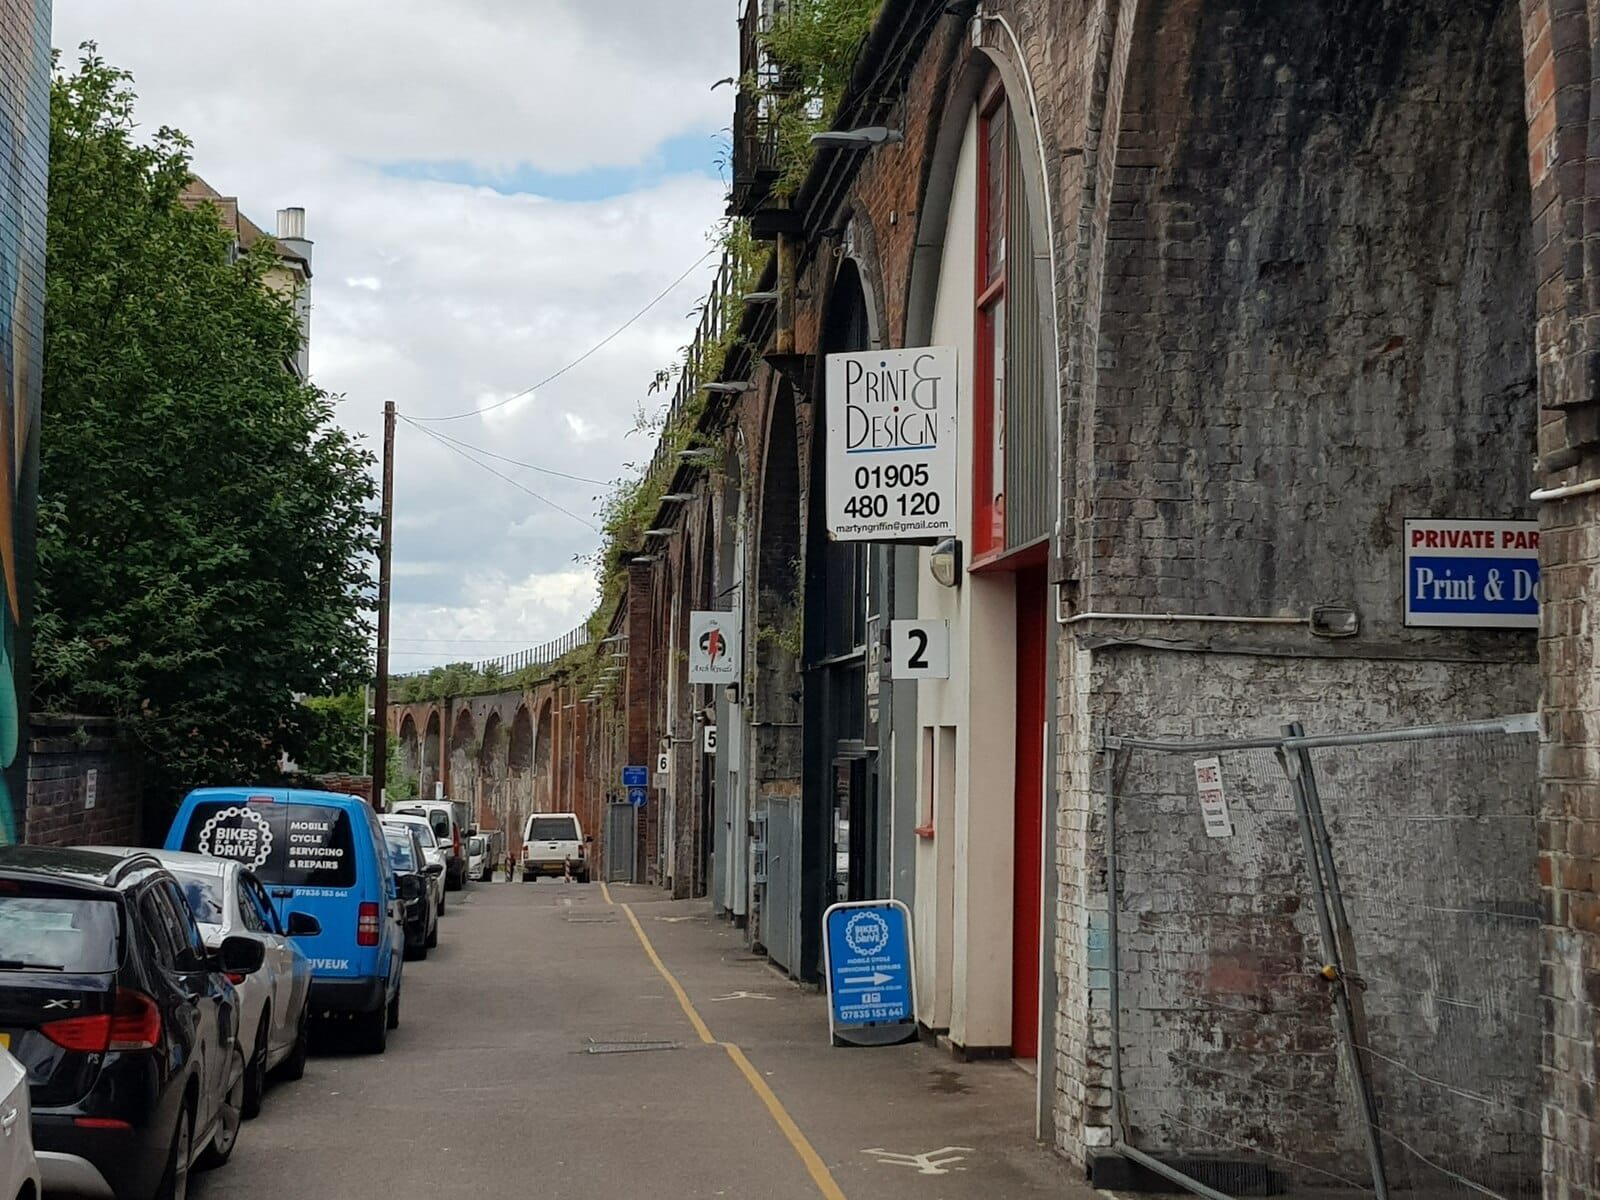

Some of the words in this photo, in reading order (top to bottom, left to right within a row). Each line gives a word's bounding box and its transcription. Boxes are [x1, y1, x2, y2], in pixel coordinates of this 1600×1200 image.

[855, 463, 929, 489] 01905
[844, 494, 888, 518] 480
[896, 492, 940, 516] 120
[836, 520, 949, 533] martyngriffin@gmail.com
[1411, 530, 1495, 549] PRIVATE
[1415, 567, 1476, 600] Print
[1483, 568, 1504, 601] &
[908, 629, 928, 669] 2
[708, 731, 717, 748] 5
[660, 757, 667, 770] 6
[290, 822, 329, 831] MOBILE
[215, 828, 258, 840] BIKES
[290, 834, 322, 843] CYCLE
[214, 844, 257, 857] DRIVE
[289, 847, 344, 857] SERVICING
[289, 860, 296, 868] &
[297, 860, 338, 870] REPAIRS
[842, 1011, 870, 1019] 07835
[888, 1008, 903, 1016] 641
